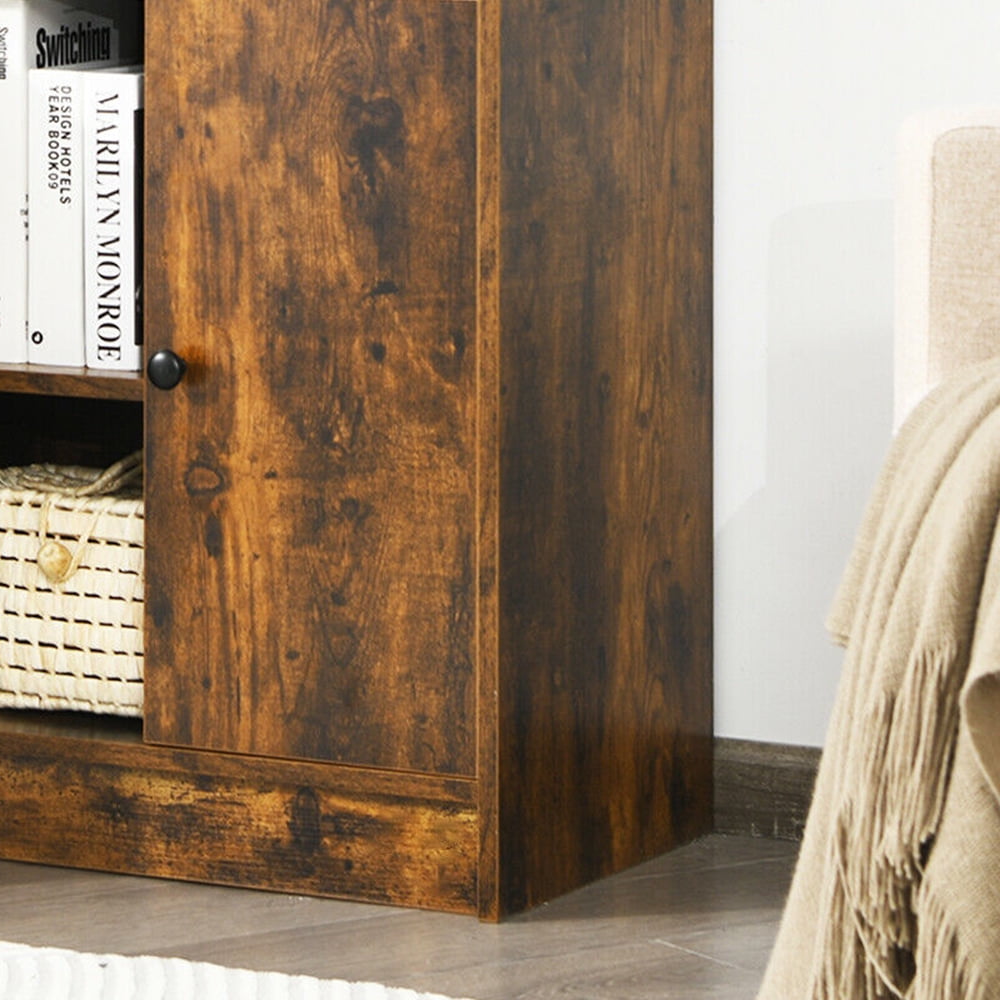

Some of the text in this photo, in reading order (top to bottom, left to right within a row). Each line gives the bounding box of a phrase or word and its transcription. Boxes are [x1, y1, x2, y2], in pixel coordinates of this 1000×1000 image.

[35, 21, 111, 69] Switching
[48, 85, 60, 124] YEAR
[59, 85, 72, 206] DESIGN HOTELS
[96, 92, 122, 361] MARILYN MONROE
